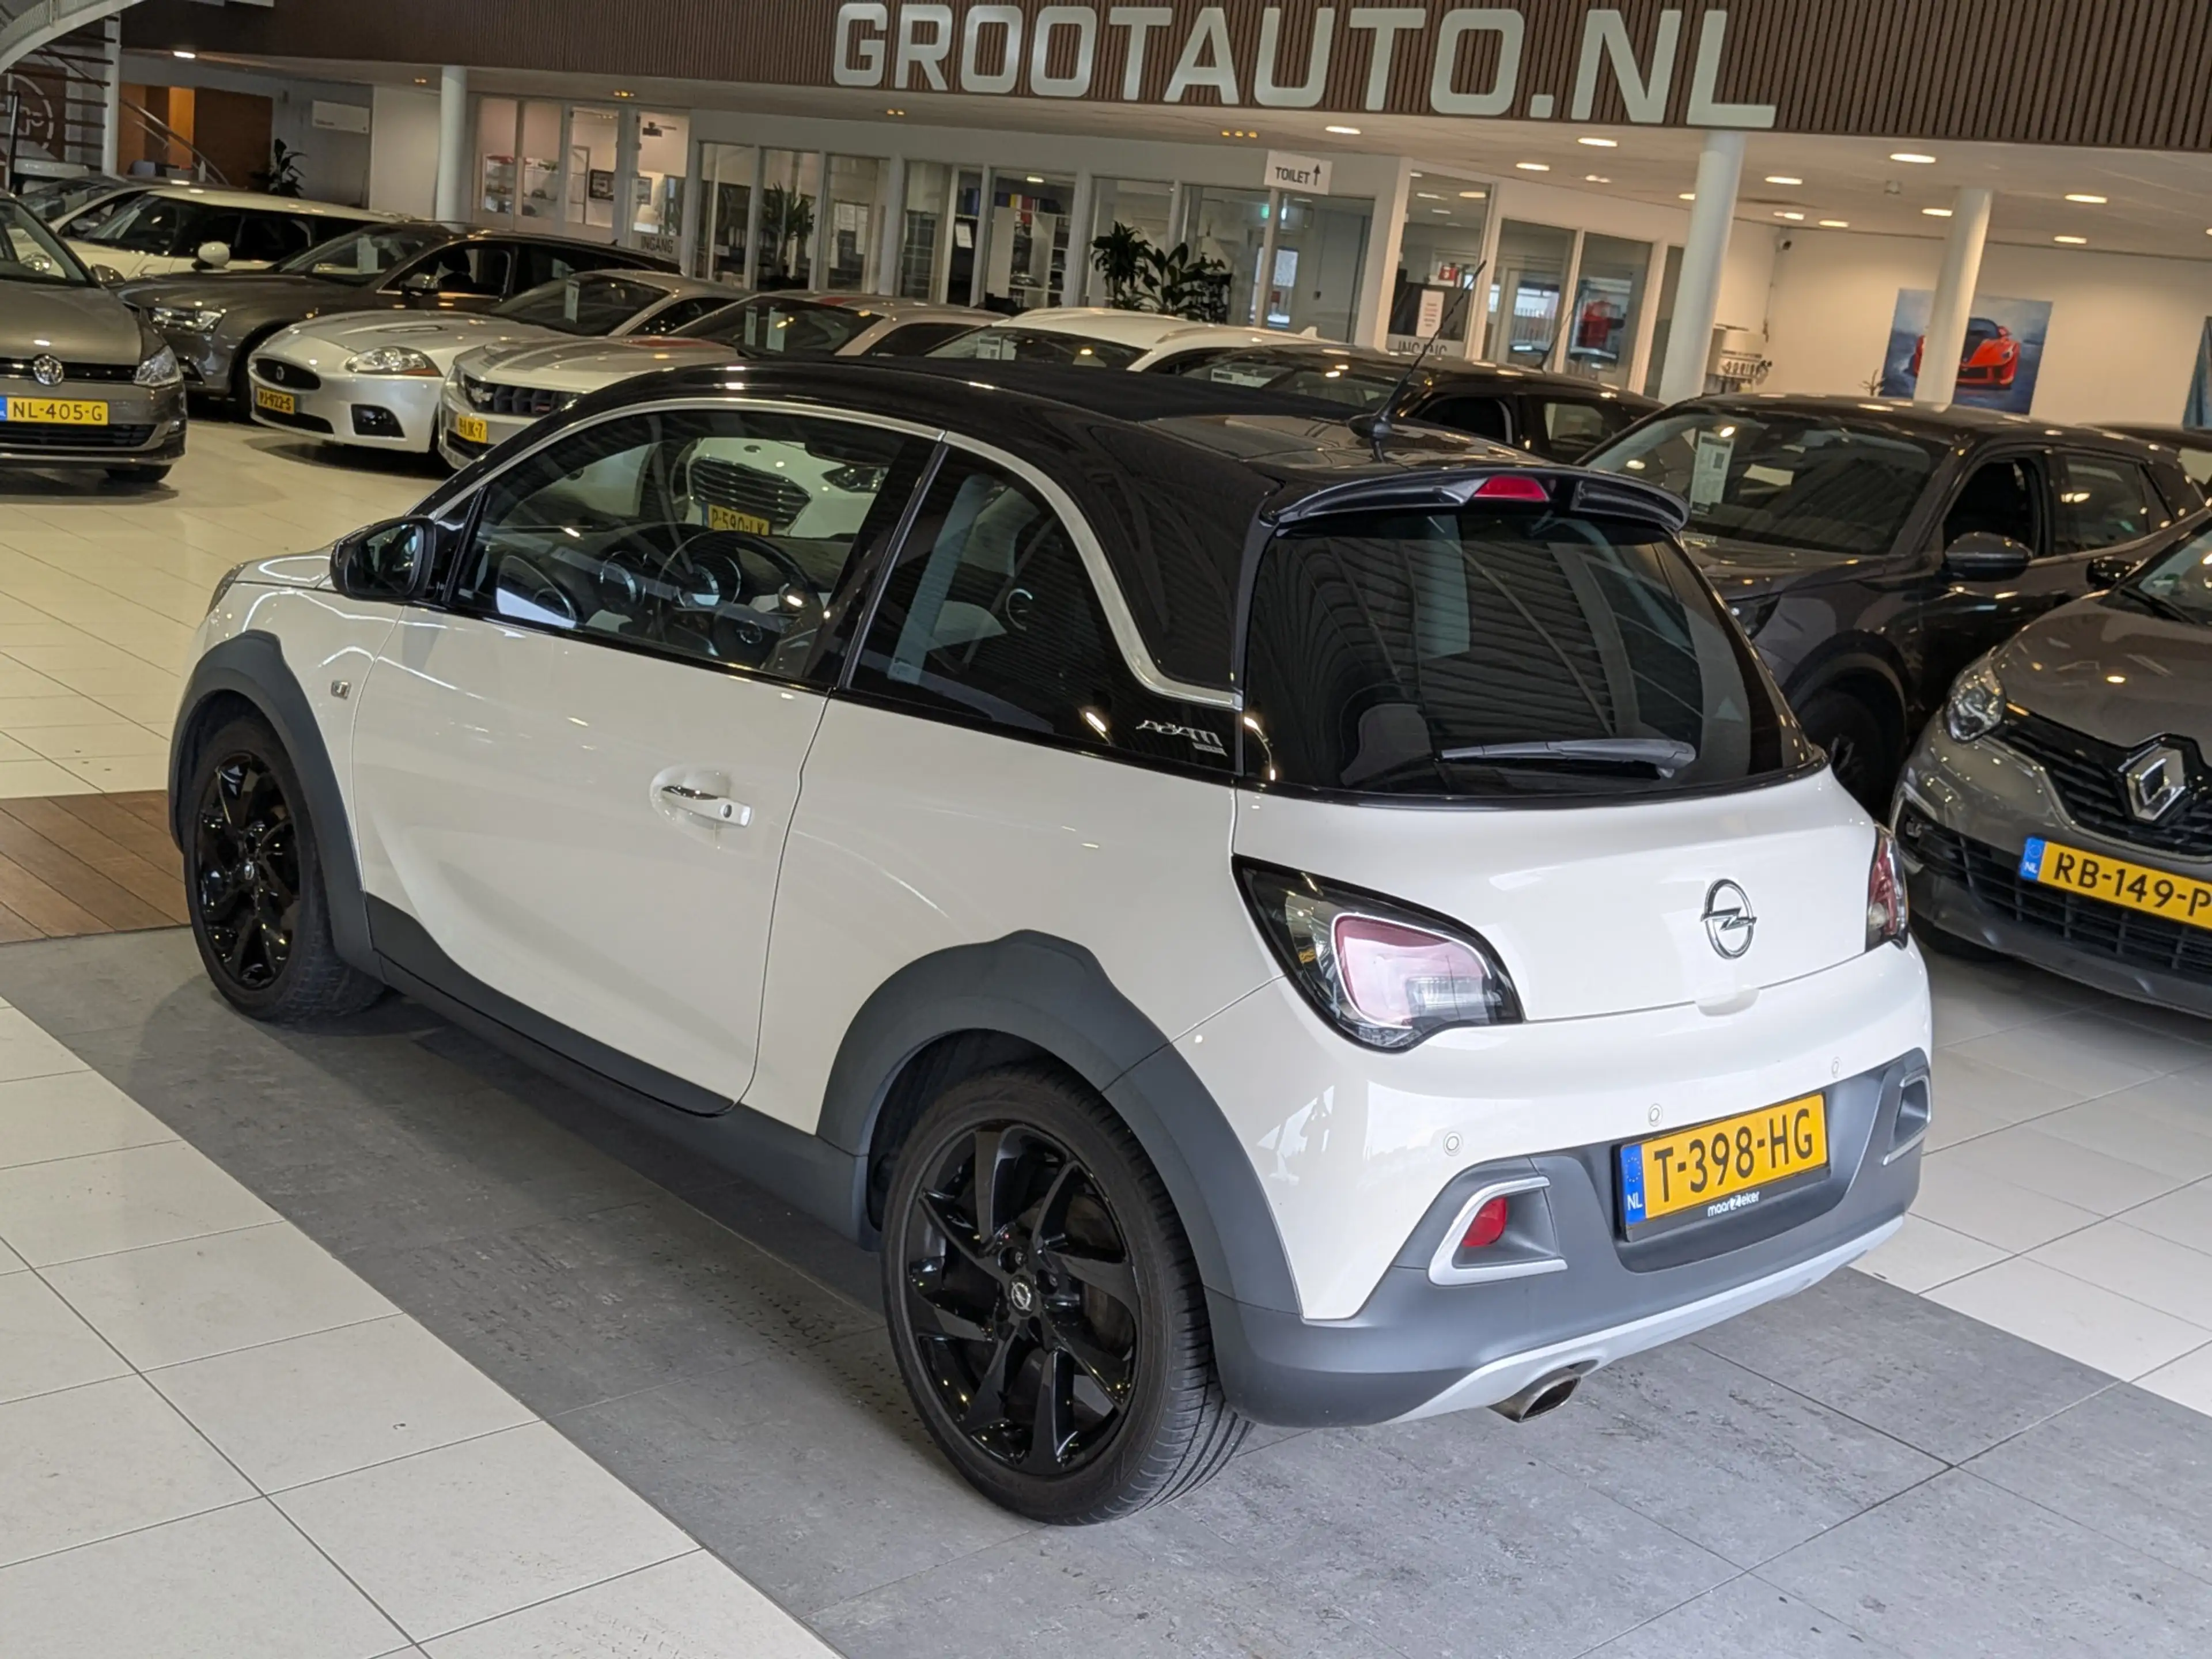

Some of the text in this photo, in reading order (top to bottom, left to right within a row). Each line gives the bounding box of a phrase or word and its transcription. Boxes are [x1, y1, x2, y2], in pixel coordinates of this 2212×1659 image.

[833, 2, 1777, 128] GROOTAUTO.NL
[1275, 166, 1310, 184] TOILET
[640, 235, 673, 254] INGANG
[13, 401, 103, 421] NL-405-G
[2023, 851, 2211, 917] NL RB-149-P
[1626, 1108, 1813, 1211] NL T-398-HG
